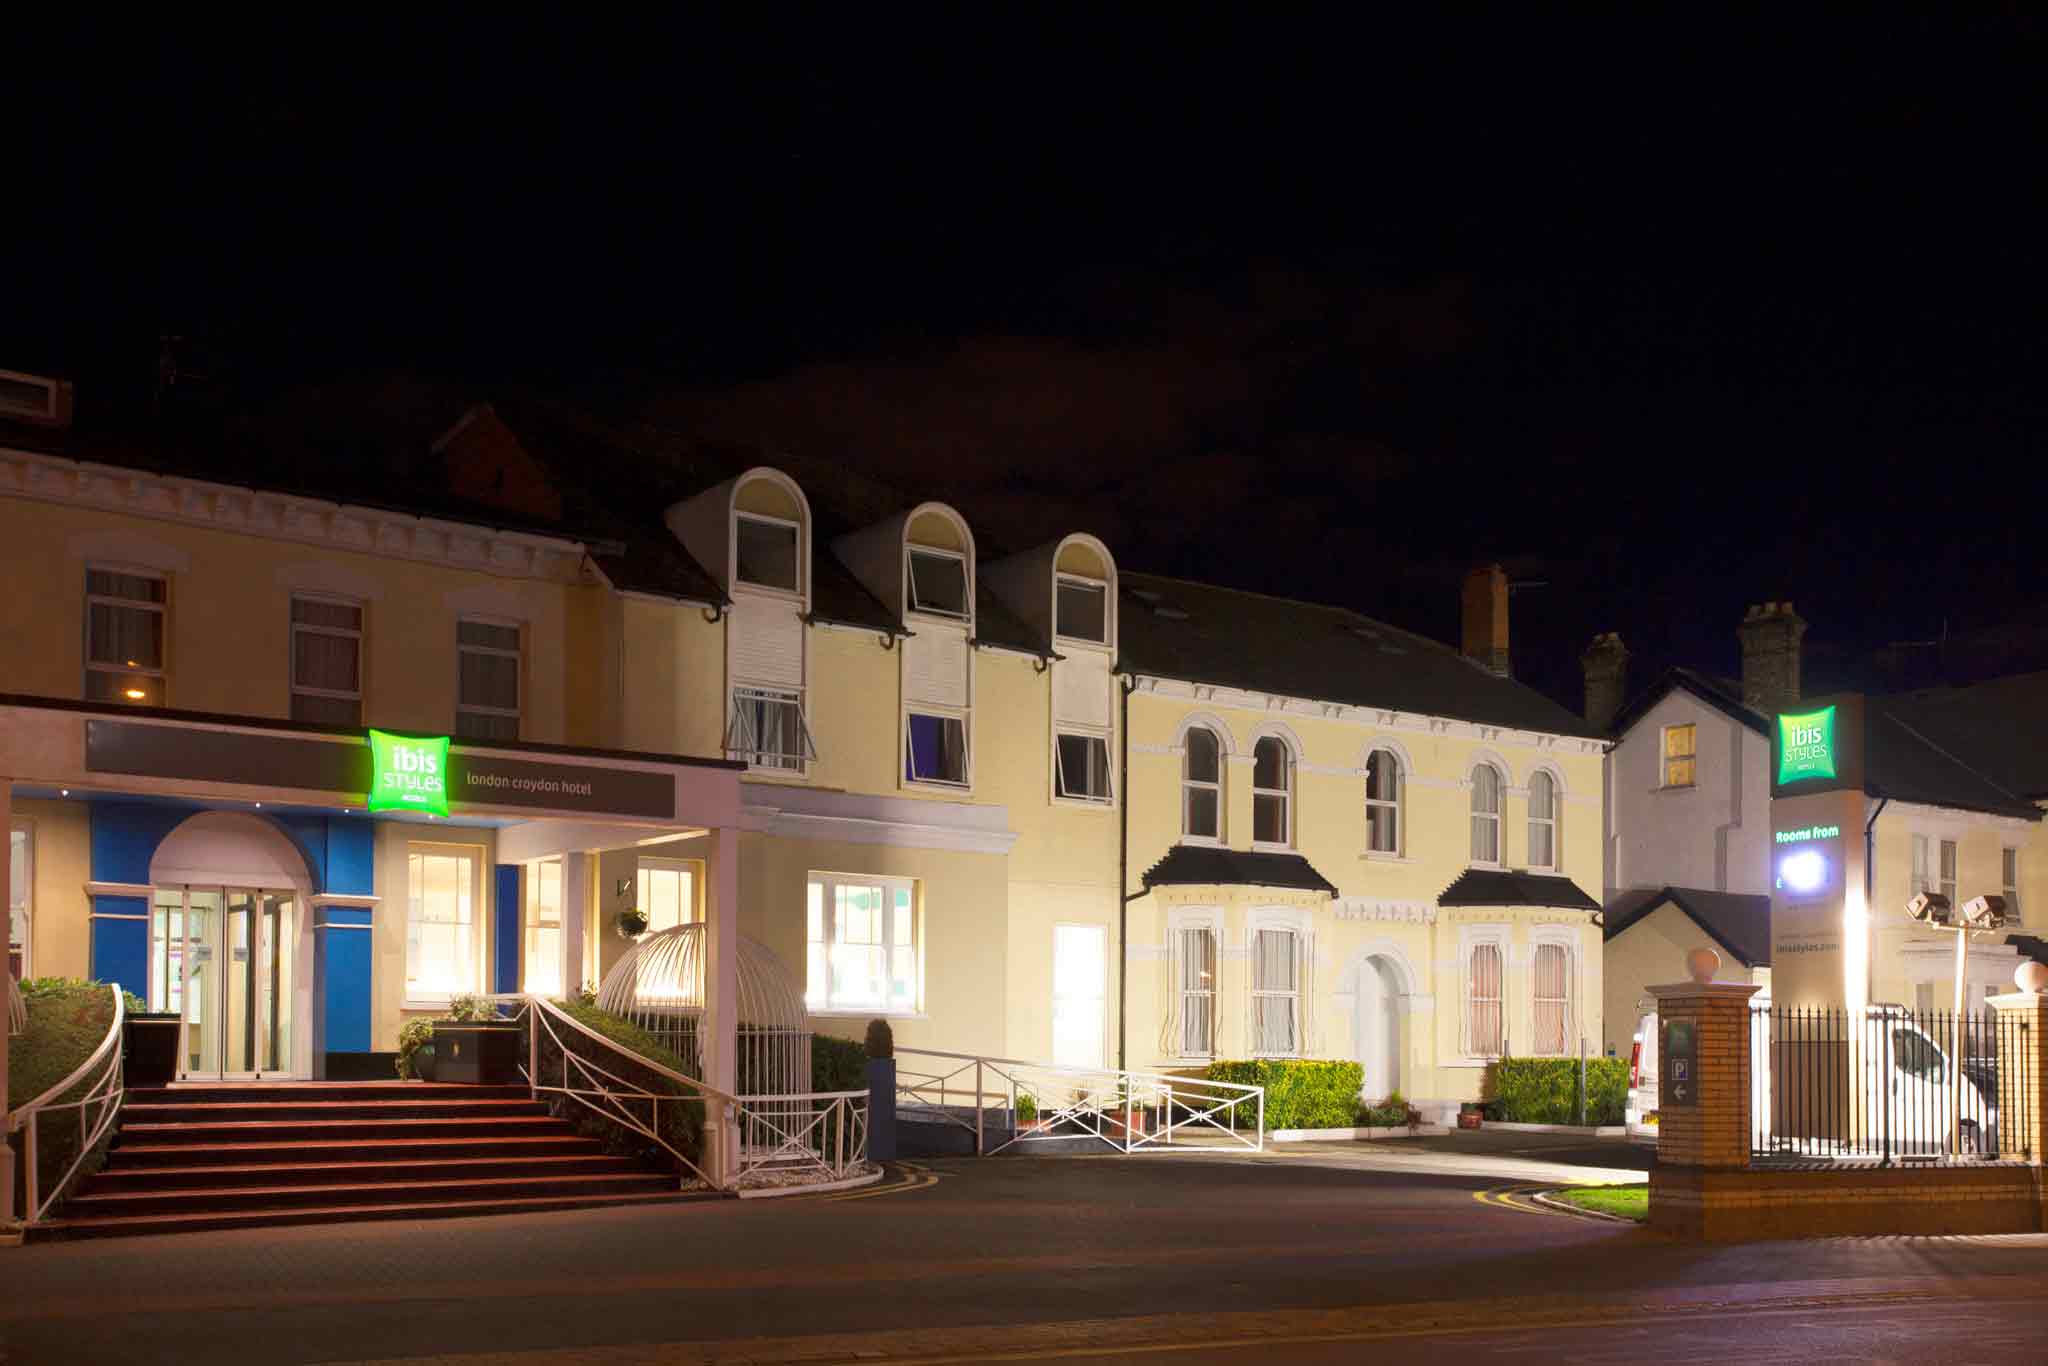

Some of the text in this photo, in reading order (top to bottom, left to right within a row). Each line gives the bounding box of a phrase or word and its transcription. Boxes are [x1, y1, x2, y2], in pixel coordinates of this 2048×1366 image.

[1791, 724, 1822, 747] ibis
[392, 746, 437, 774] ibis
[466, 771, 592, 795] london croydon hotel
[1776, 826, 1839, 843] Rooms from
